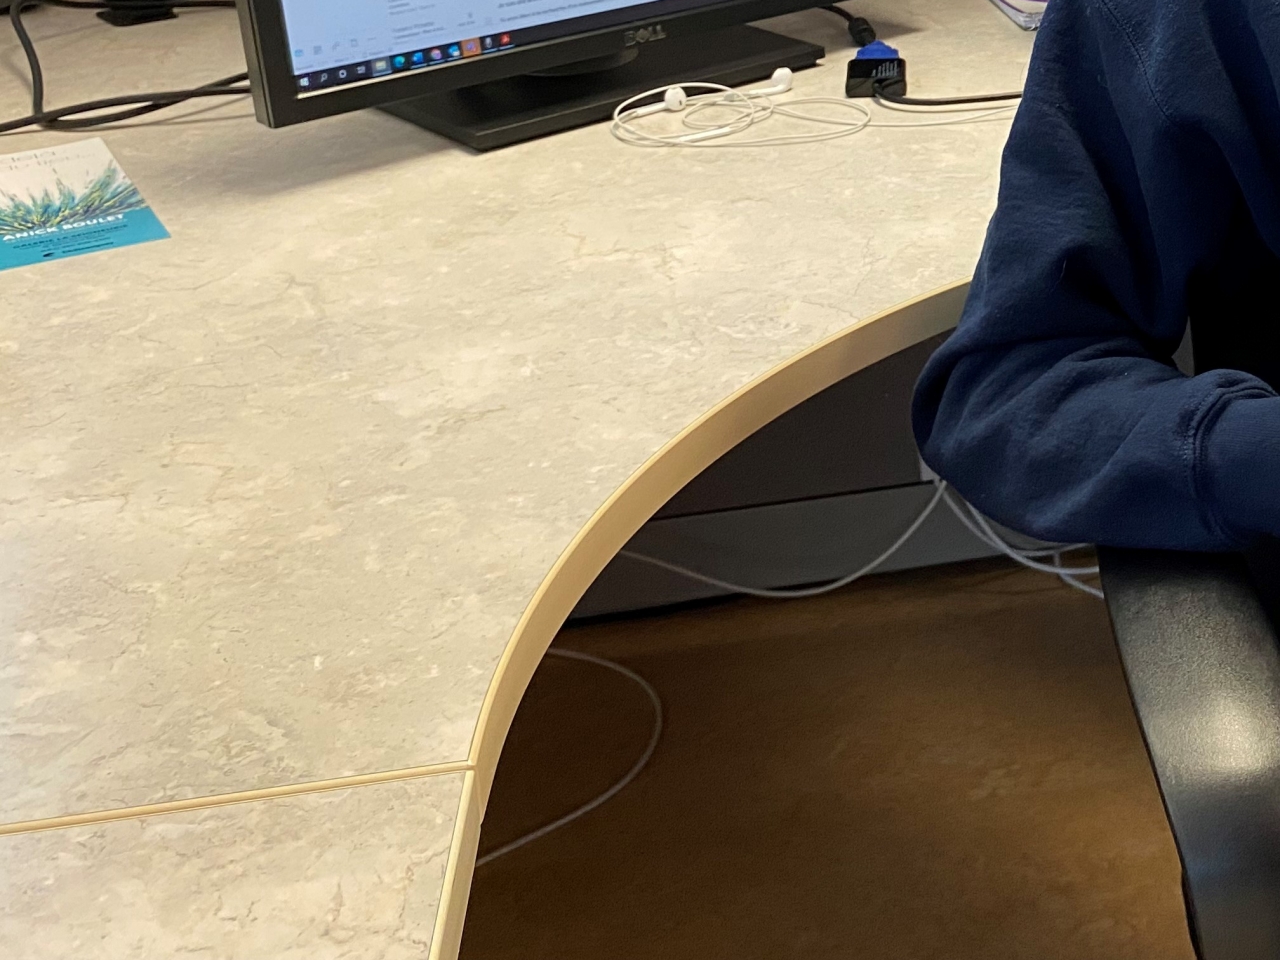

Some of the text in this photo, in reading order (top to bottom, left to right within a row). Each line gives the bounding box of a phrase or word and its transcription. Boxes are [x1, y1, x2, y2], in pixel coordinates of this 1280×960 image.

[624, 24, 667, 48] DELL
[2, 213, 125, 241] ANICK BOULET
